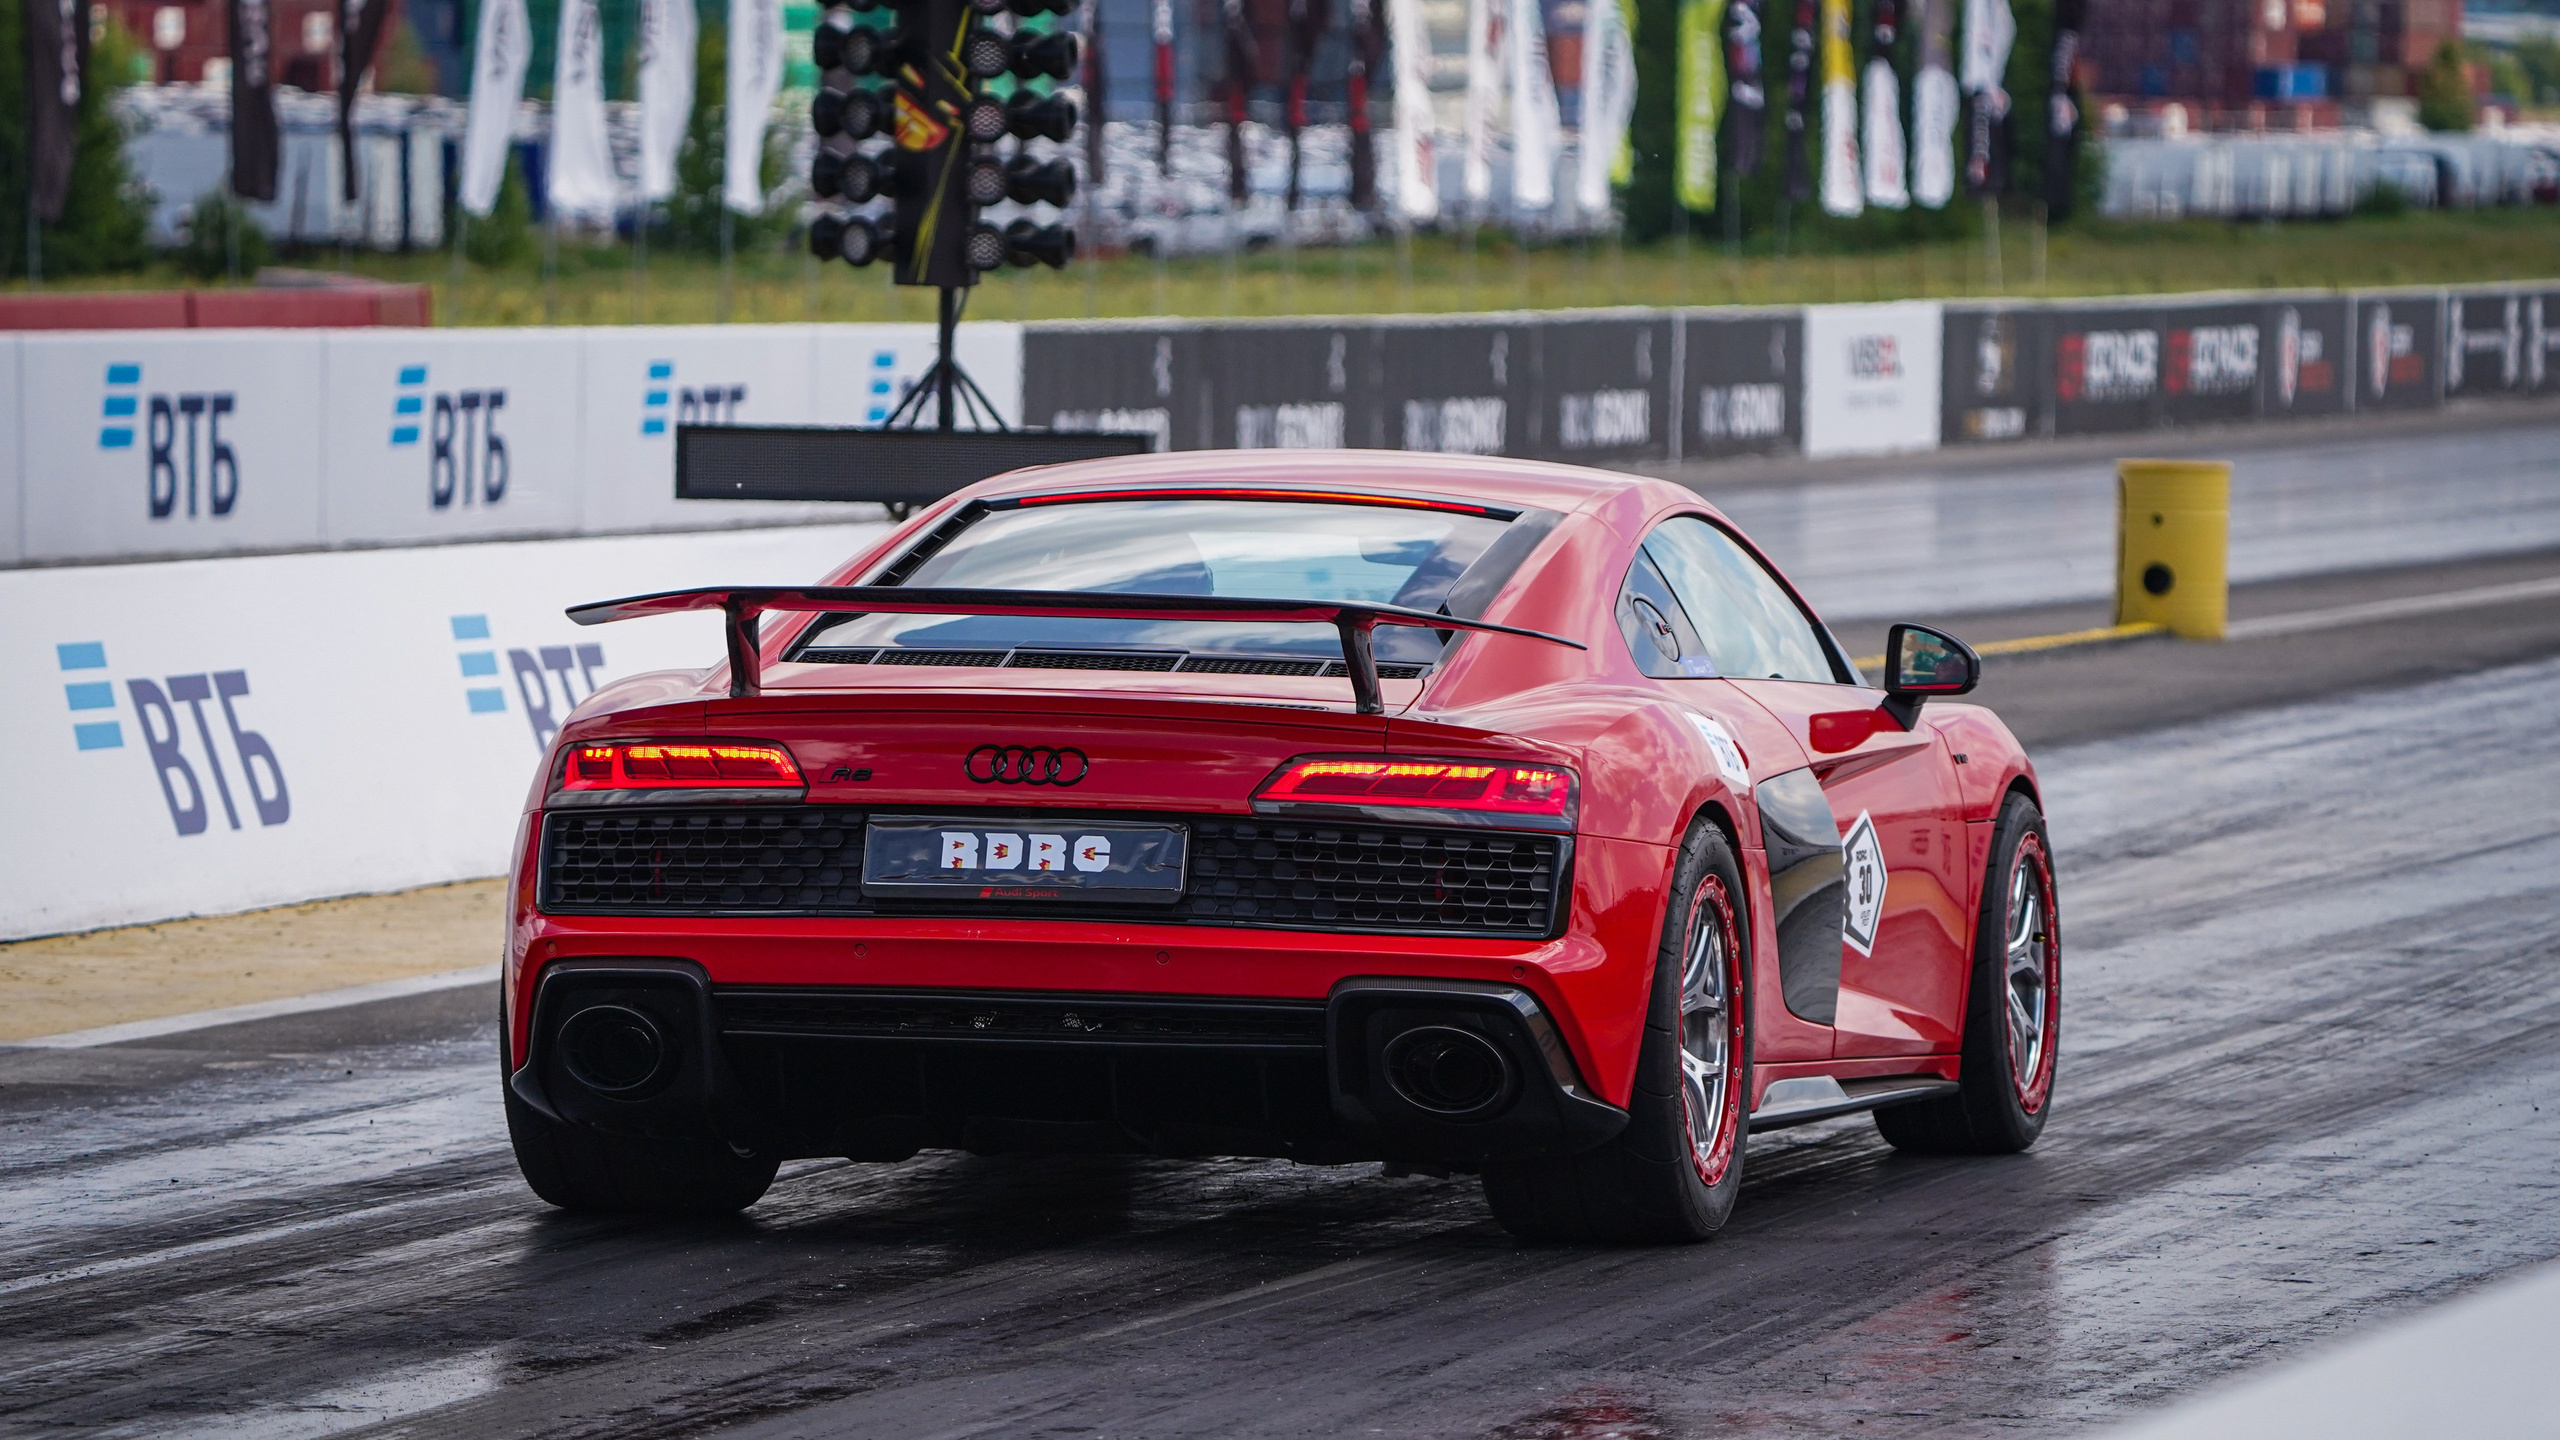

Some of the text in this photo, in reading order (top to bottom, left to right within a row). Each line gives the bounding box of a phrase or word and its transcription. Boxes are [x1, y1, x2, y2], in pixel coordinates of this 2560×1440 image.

[148, 393, 240, 519] ВТБ
[431, 389, 510, 509] ВТБ
[126, 668, 291, 837] ВТБ
[830, 767, 873, 781] R8
[940, 831, 1112, 873] RDRC
[995, 887, 1058, 899] Audi Sport
[1859, 864, 1872, 905] 30
